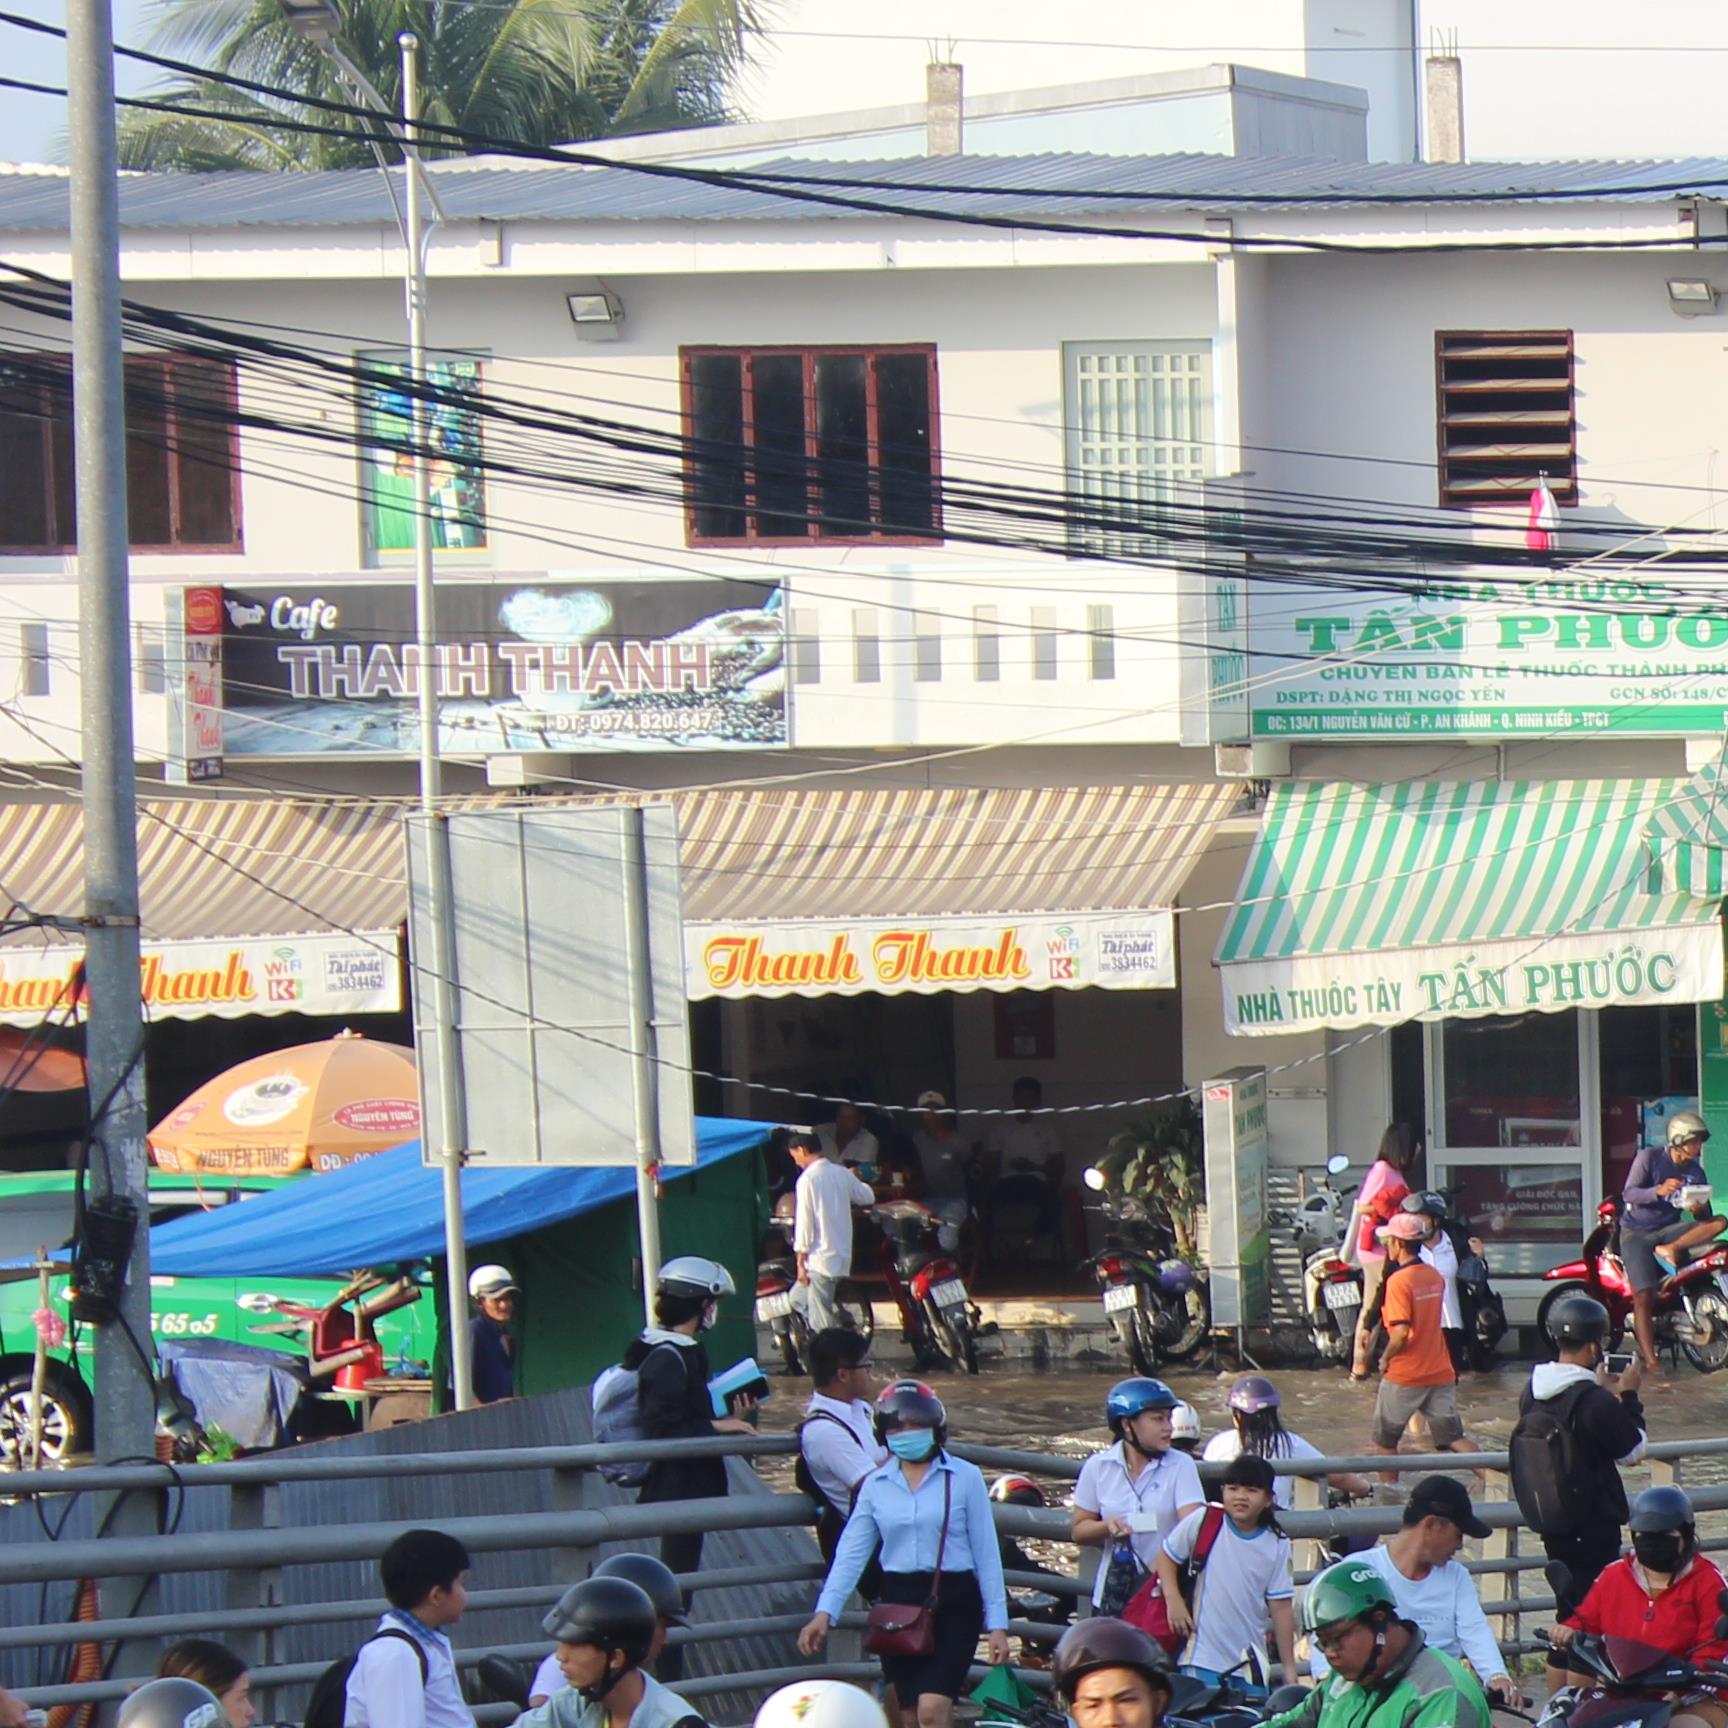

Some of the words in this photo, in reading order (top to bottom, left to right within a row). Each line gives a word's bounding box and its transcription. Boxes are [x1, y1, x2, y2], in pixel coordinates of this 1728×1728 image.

[269, 594, 338, 641] Cafe
[1294, 605, 1469, 652] TẤN
[499, 640, 711, 695] THANH
[1276, 690, 1325, 705] DSPT:
[1382, 690, 1414, 707] THỊ
[1417, 689, 1466, 706] NGỌC
[1471, 686, 1507, 702] YẾN
[1609, 687, 1646, 701] GCN
[556, 713, 587, 731] ĐT:
[589, 711, 714, 731] 0974.820.647
[1289, 714, 1320, 731] 134/1
[1322, 710, 1368, 731] NGUYỄN
[1370, 711, 1393, 730] VĂN
[1434, 713, 1450, 729] AN
[1452, 711, 1492, 729] KHÁNH
[1515, 711, 1544, 728] NINH
[702, 930, 860, 987] Thanh
[871, 926, 1034, 982] Thanh
[1111, 954, 1156, 971] 3834462
[336, 973, 383, 990] 3834462
[1237, 991, 1284, 1024] NHÀ
[1287, 973, 1358, 1019] THUỐC
[1362, 978, 1403, 1013] TÂY
[1417, 954, 1508, 1015] TẤN
[1524, 943, 1678, 1003] PHƯỚC
[161, 1313, 184, 1337] 65
